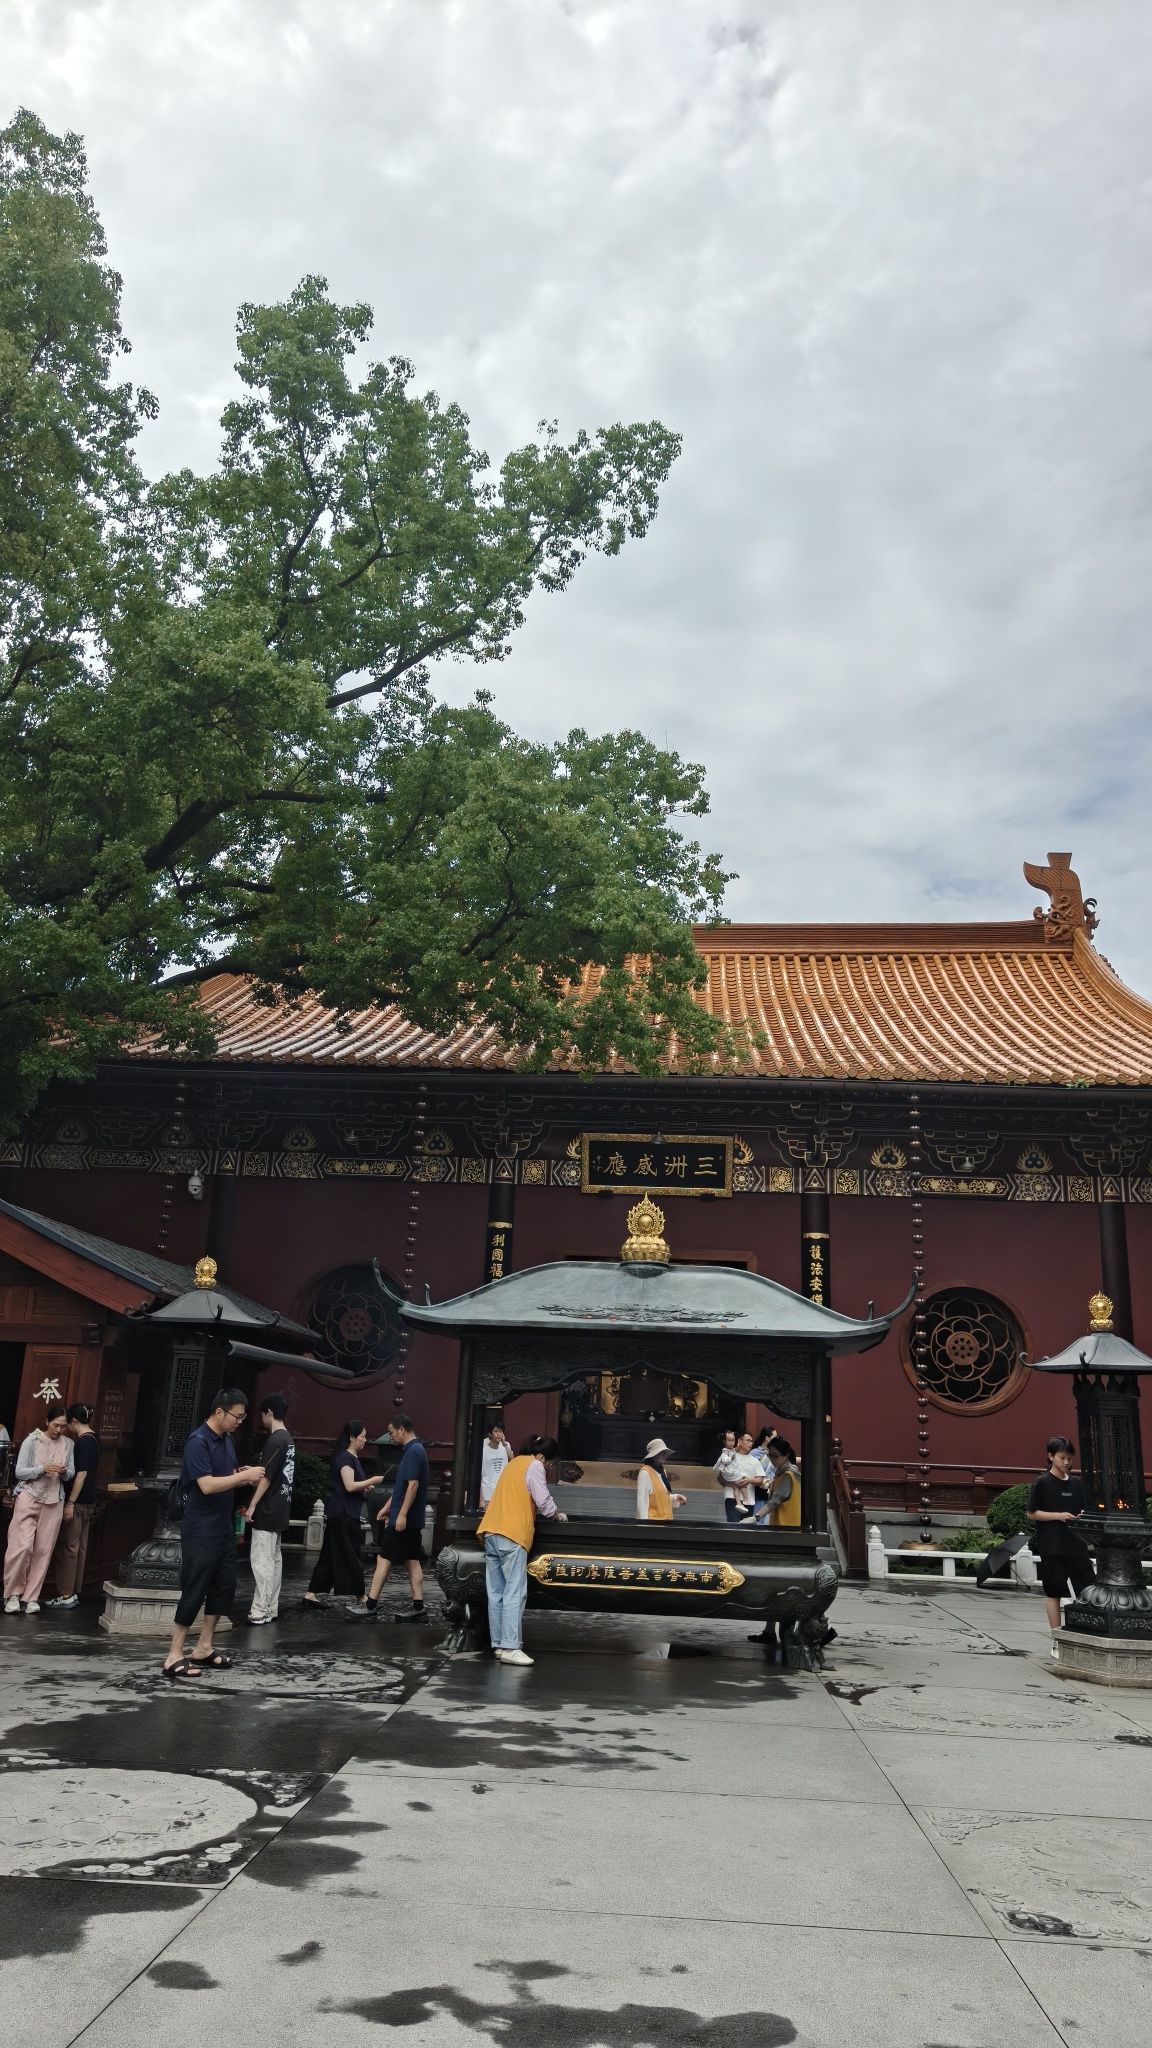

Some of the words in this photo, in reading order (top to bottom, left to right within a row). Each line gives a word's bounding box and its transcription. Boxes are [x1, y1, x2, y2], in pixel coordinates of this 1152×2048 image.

[489, 1234, 505, 1282] 利國福
[33, 1377, 62, 1404] 茶
